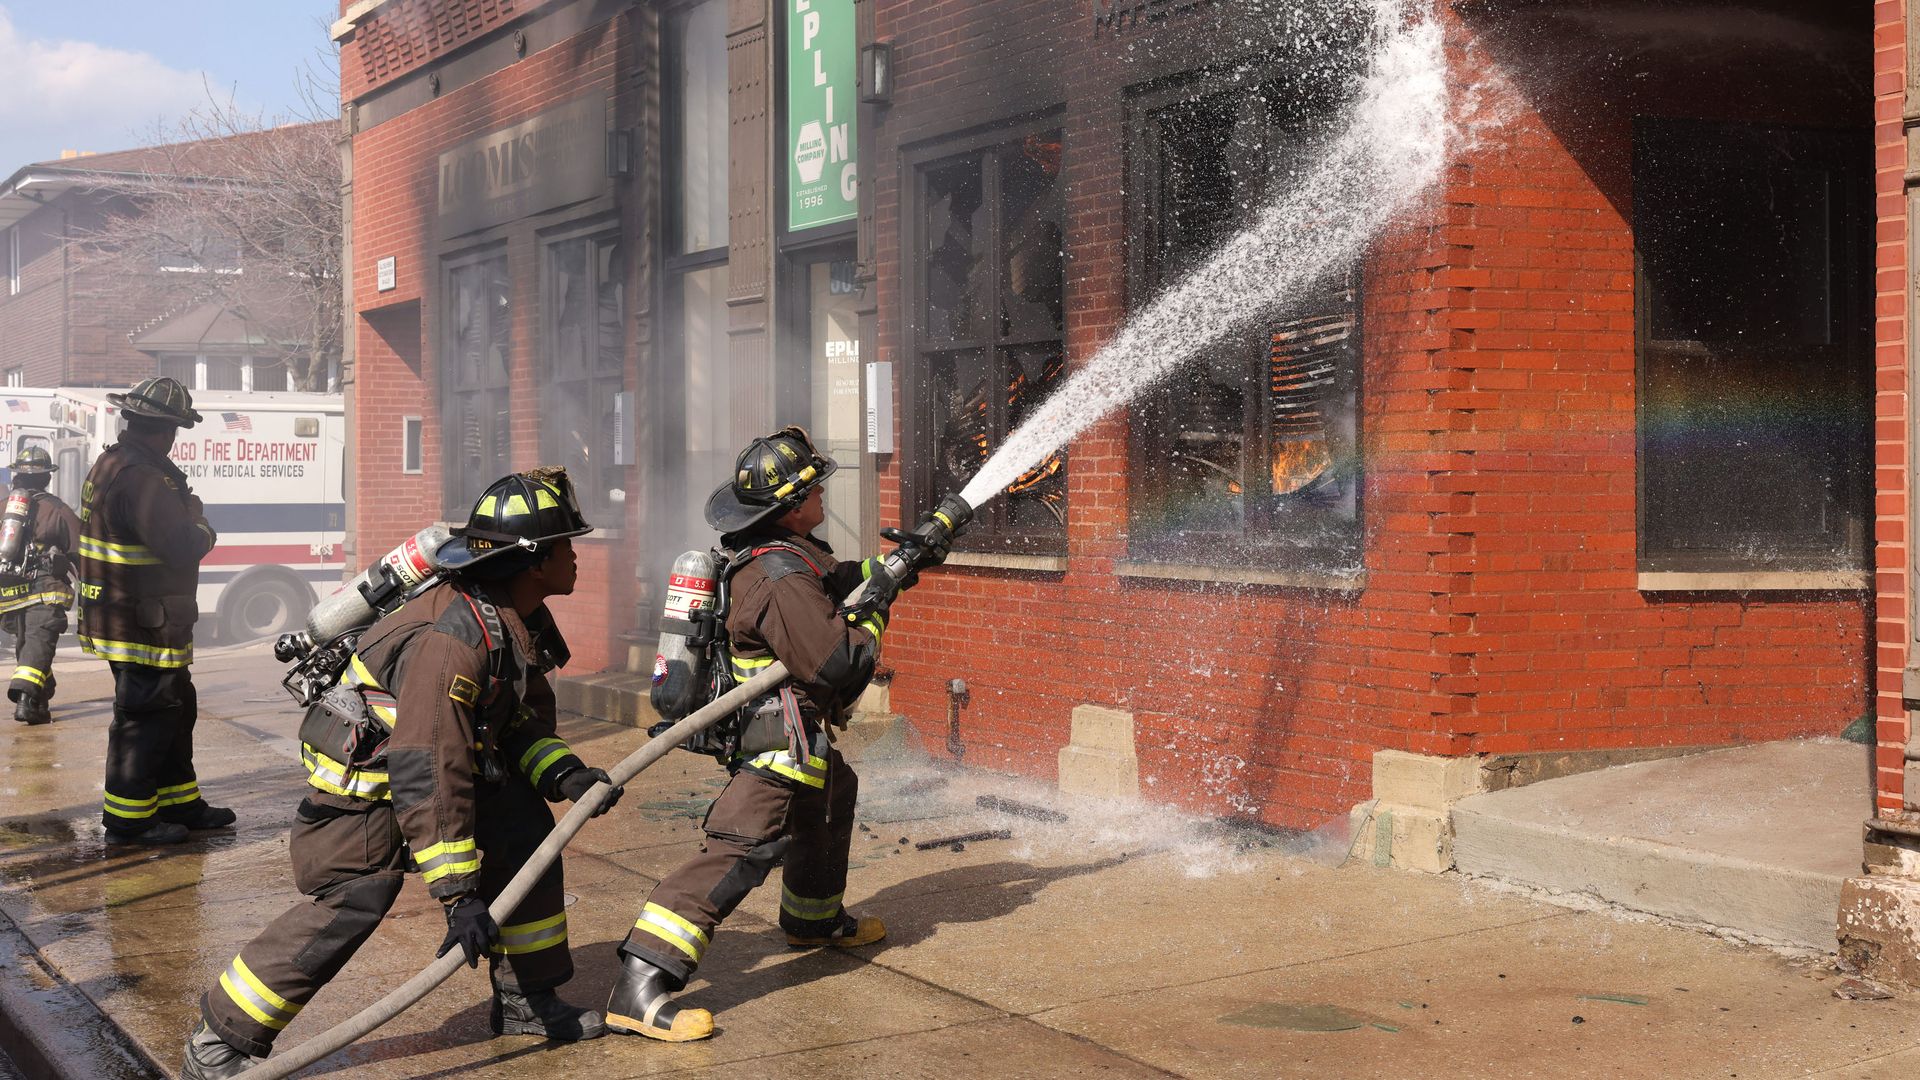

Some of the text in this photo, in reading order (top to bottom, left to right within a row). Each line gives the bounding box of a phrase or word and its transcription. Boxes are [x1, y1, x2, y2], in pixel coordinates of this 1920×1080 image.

[799, 138, 822, 152] MILLING
[797, 148, 825, 164] COMPANY
[799, 194, 824, 209] 1996
[169, 438, 317, 462] AGO FIRE DEPARTMENT
[213, 464, 255, 478] MEDICAL
[260, 464, 304, 478] SERVICES
[694, 580, 706, 589] 5.5
